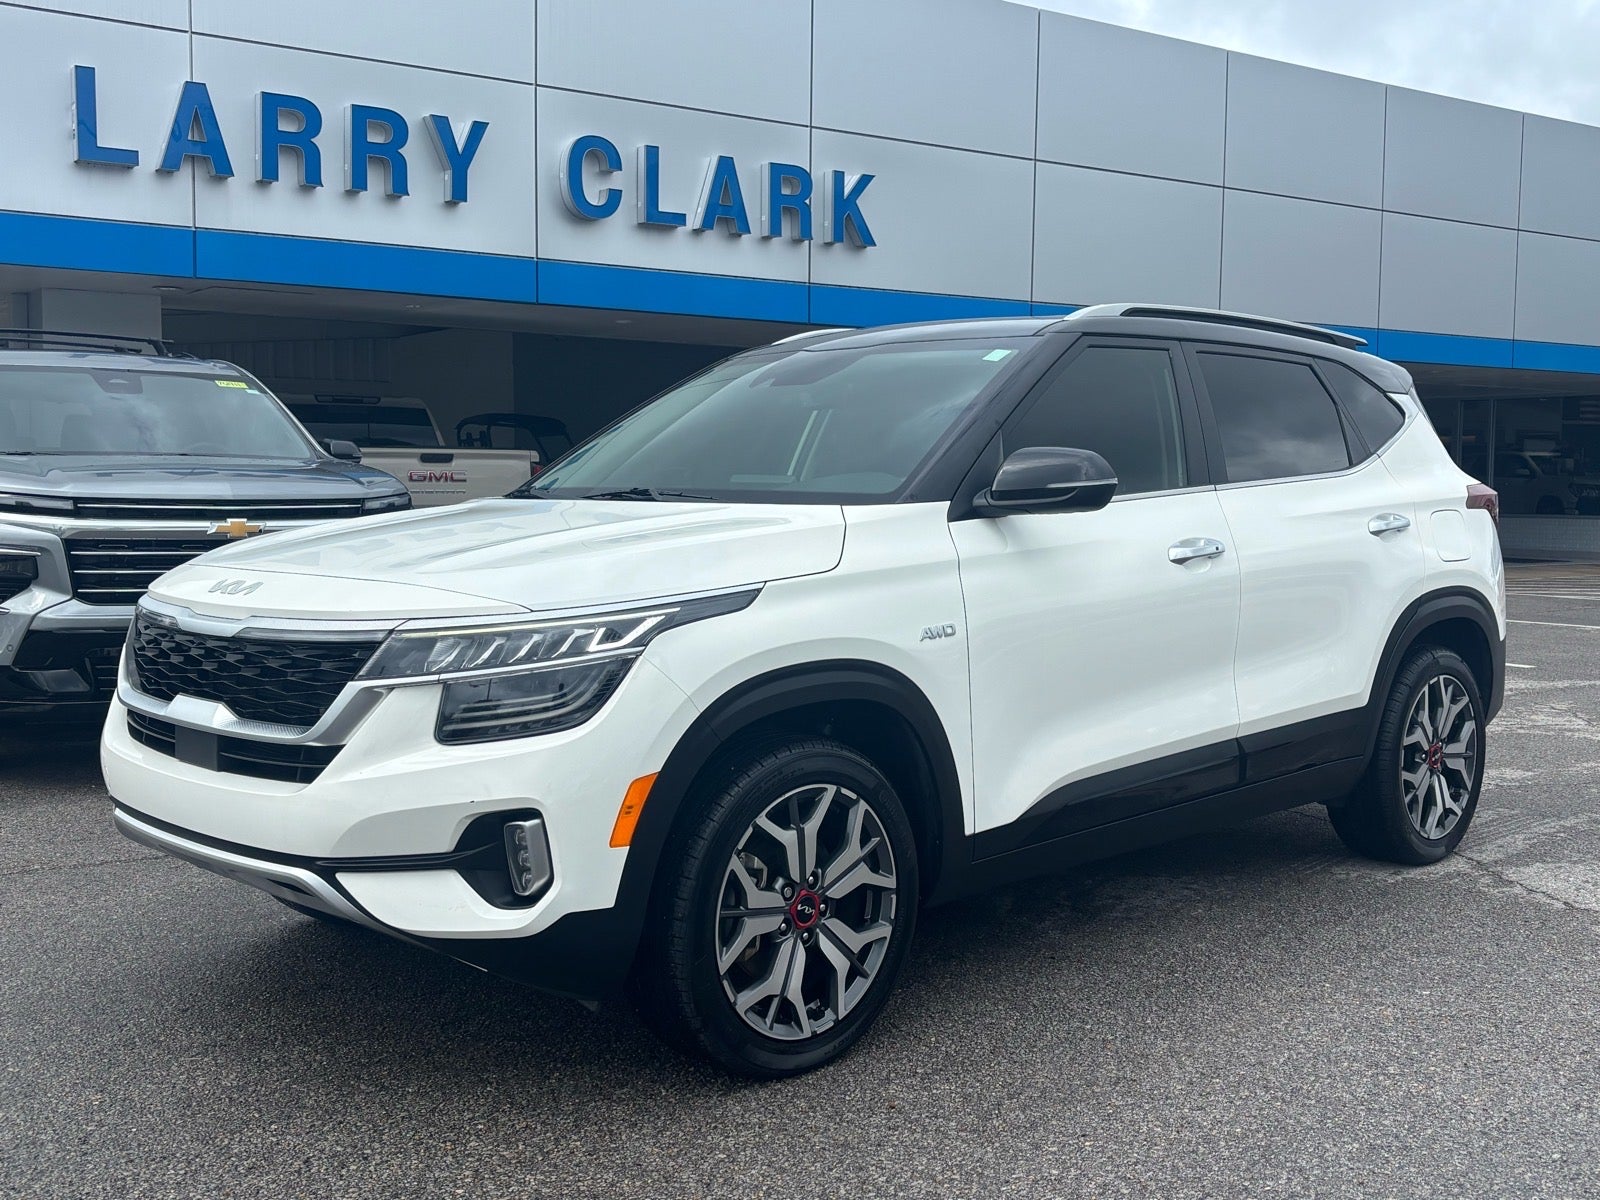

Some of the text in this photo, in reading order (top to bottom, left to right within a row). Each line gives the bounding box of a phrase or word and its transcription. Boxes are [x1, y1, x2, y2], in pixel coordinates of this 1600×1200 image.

[71, 65, 876, 248] LARRY CLARK
[407, 470, 467, 482] GMC
[920, 623, 956, 641] AWD
